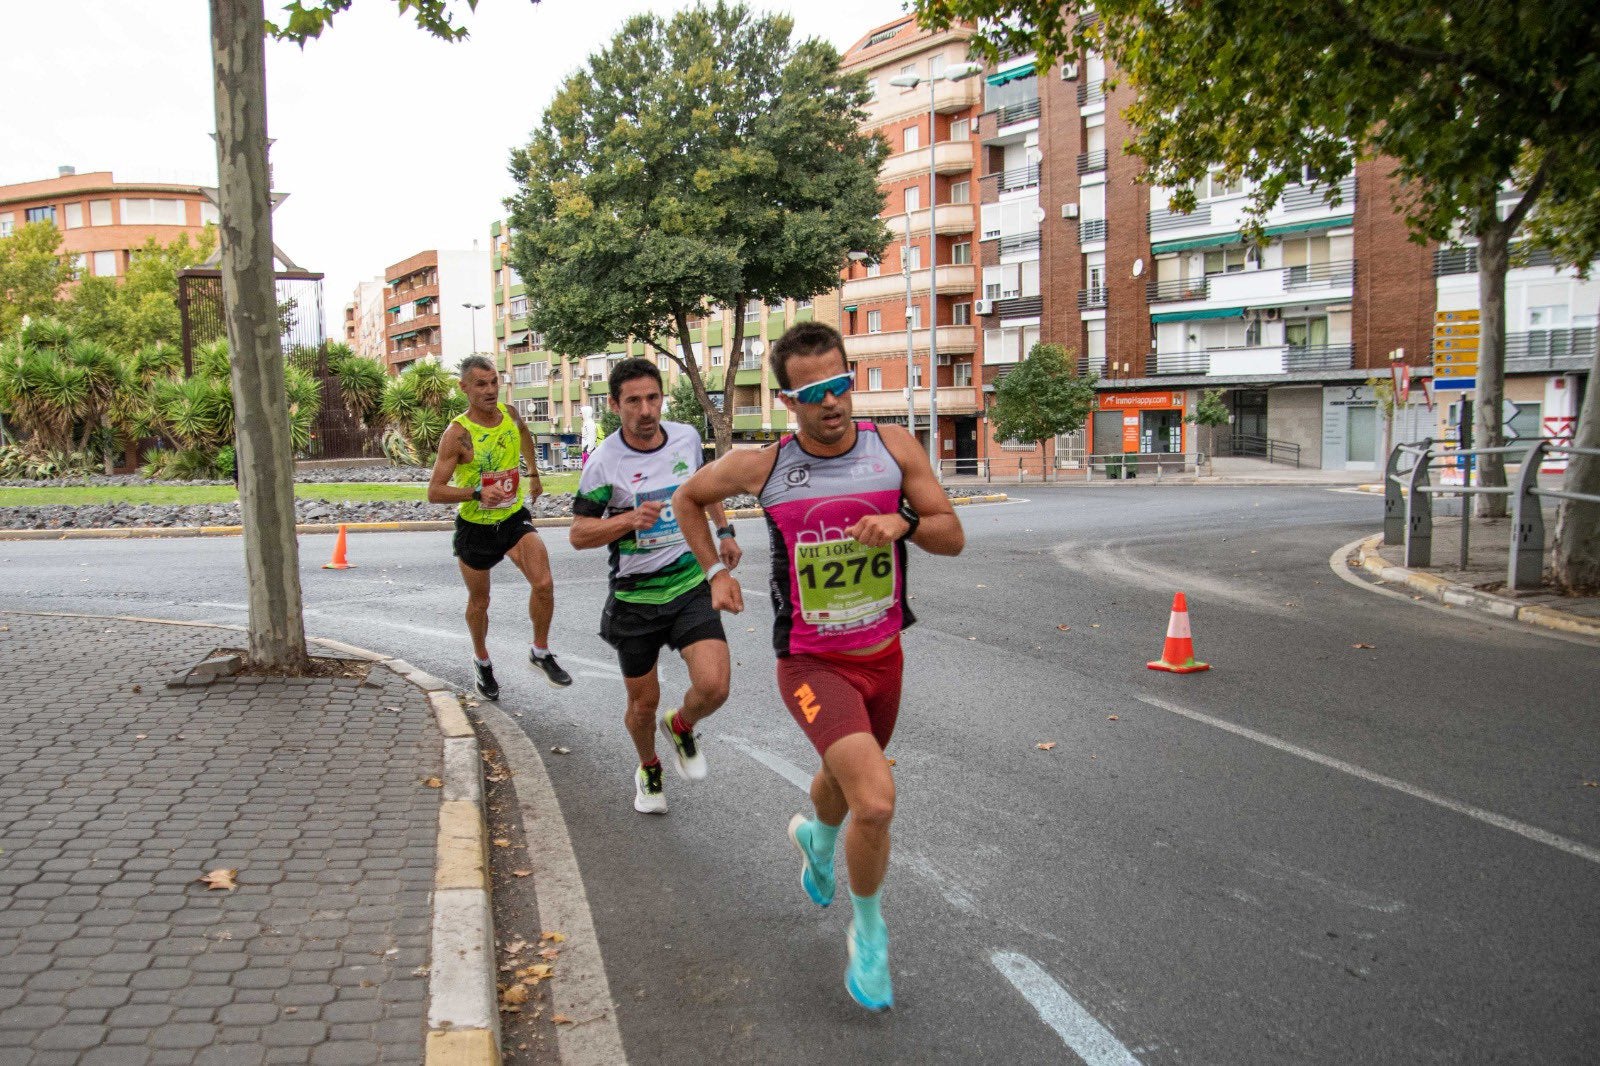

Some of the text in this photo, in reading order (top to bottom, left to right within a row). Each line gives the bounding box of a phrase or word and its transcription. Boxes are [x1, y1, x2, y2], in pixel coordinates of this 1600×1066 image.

[799, 546, 820, 558] VII
[826, 543, 855, 556] 10K
[799, 552, 892, 590] 1276
[793, 683, 822, 724] FILA
